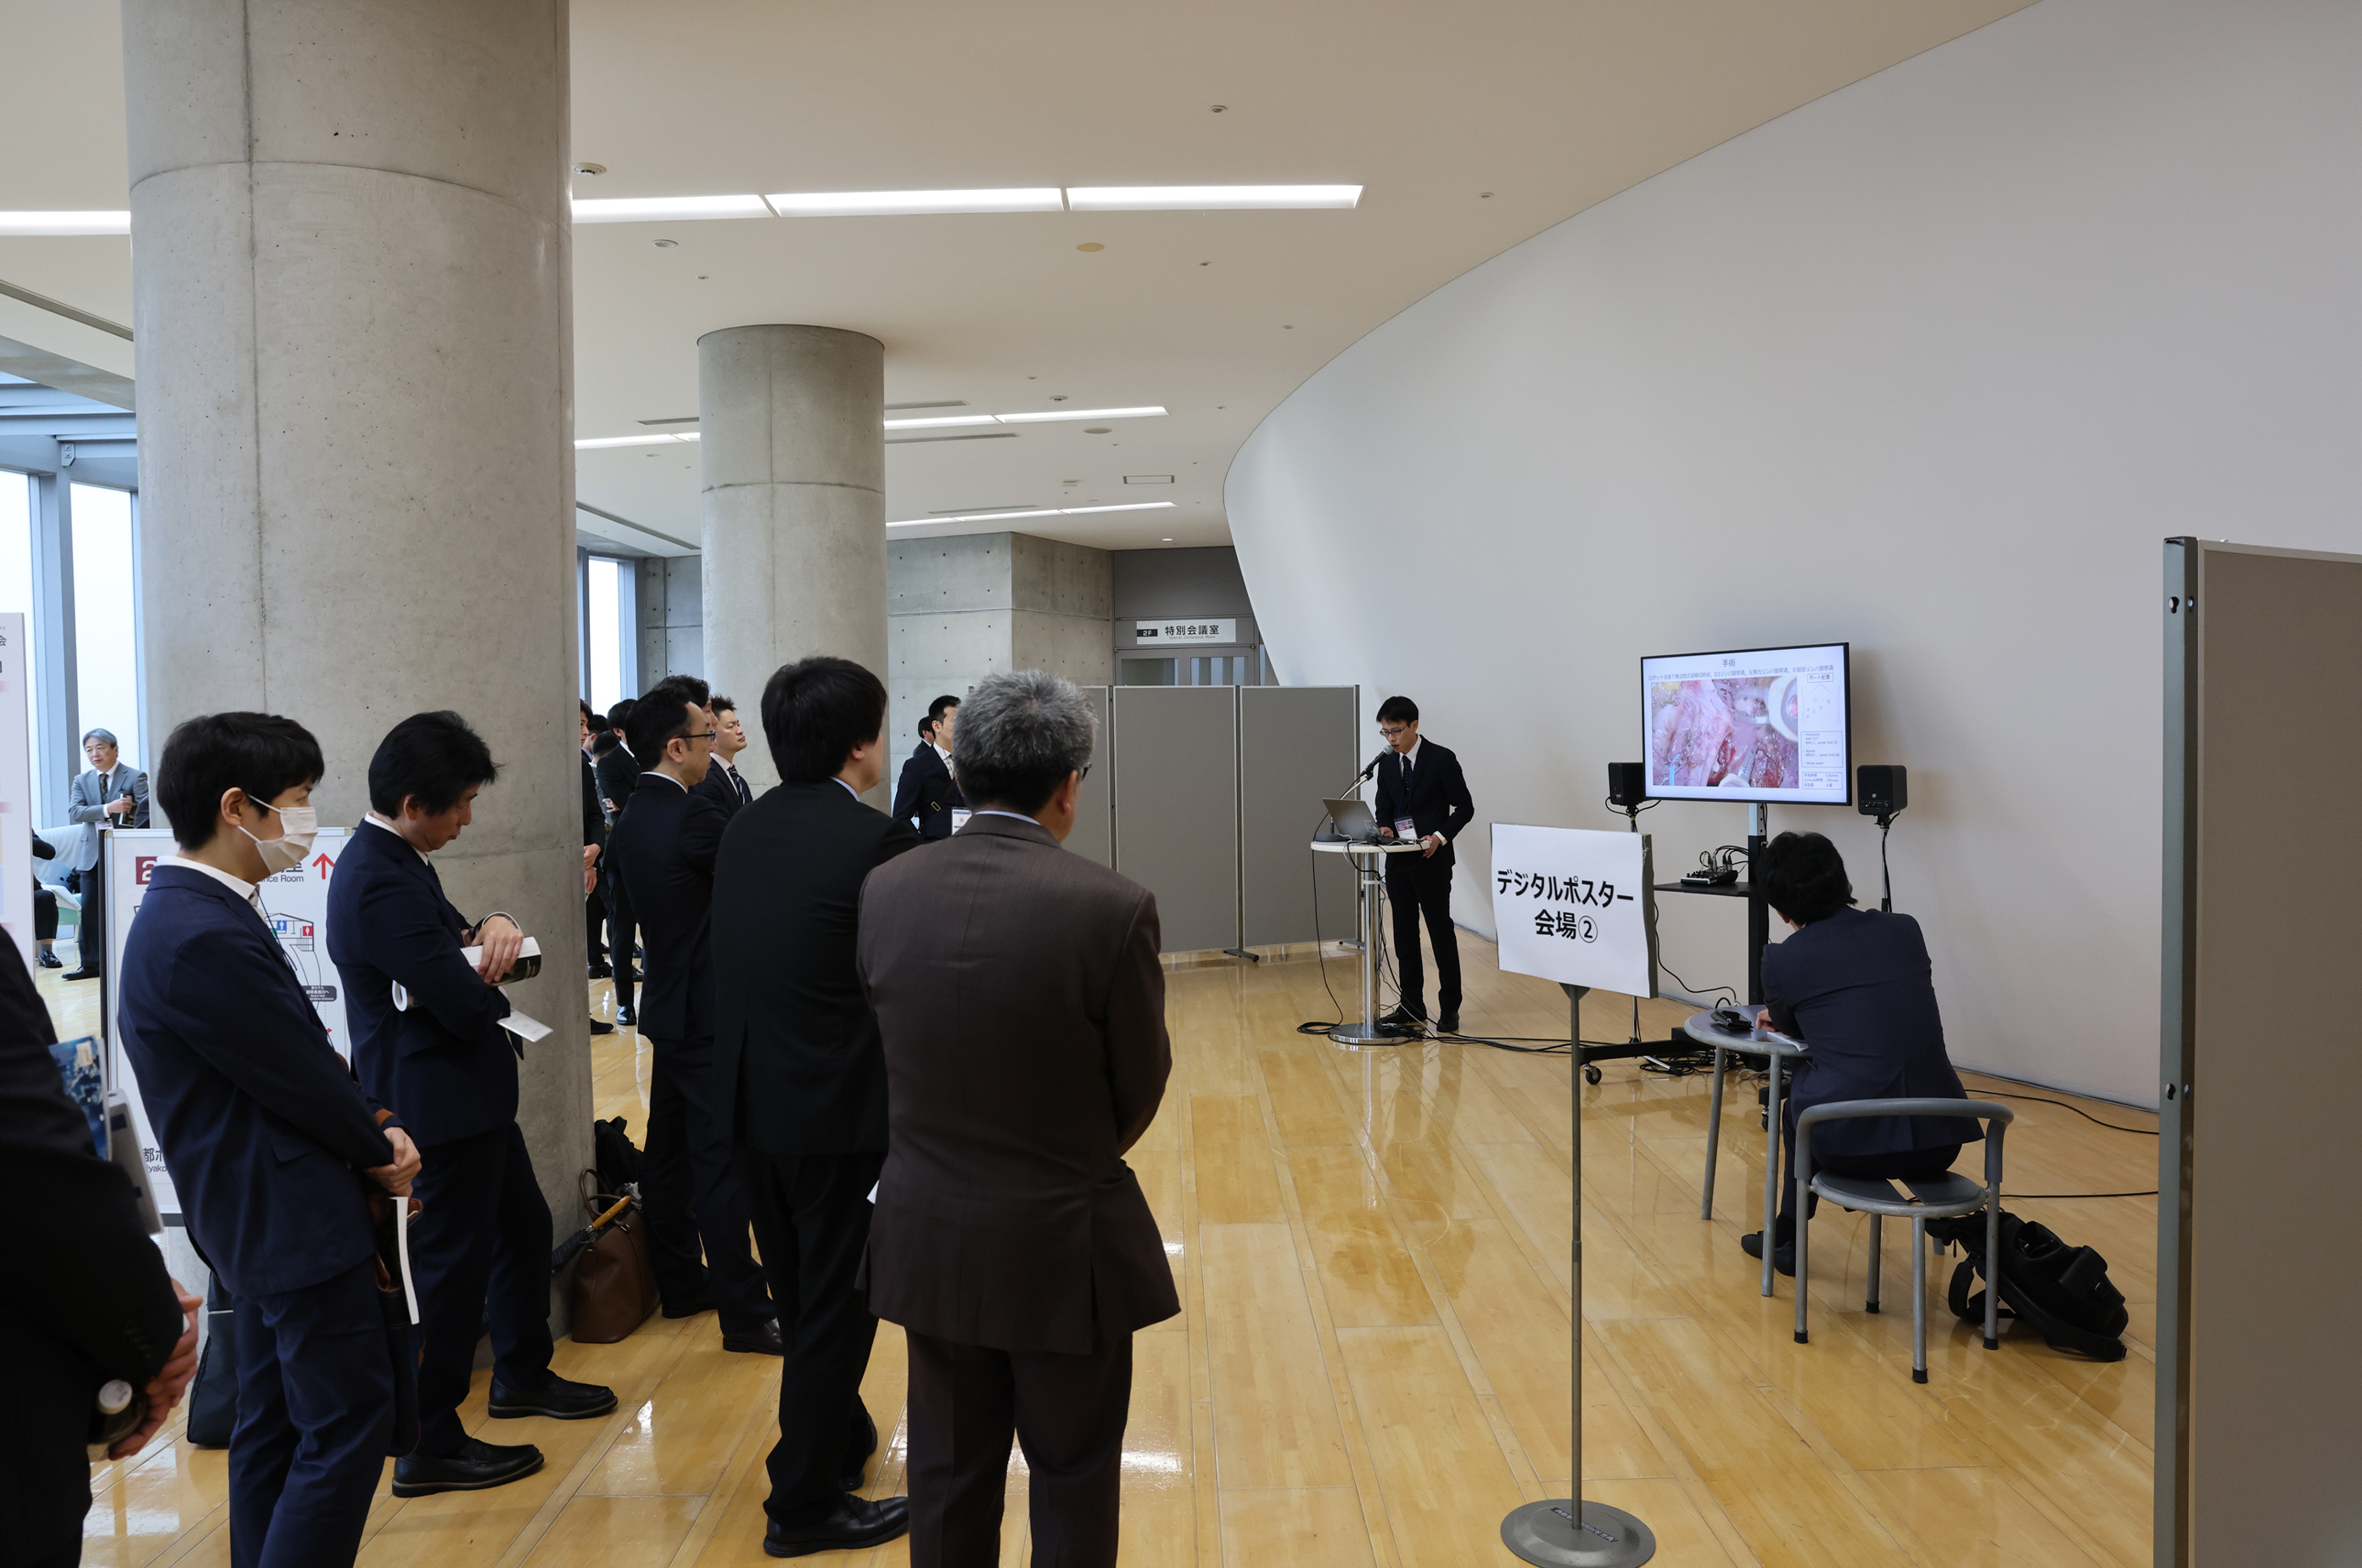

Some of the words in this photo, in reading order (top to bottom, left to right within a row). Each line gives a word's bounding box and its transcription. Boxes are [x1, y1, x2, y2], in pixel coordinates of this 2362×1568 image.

[1165, 624, 1219, 636] 特別会議室
[1722, 658, 1736, 667] 手術
[1497, 868, 1634, 908] デジタルポスター
[1534, 909, 1598, 944] 会場②
